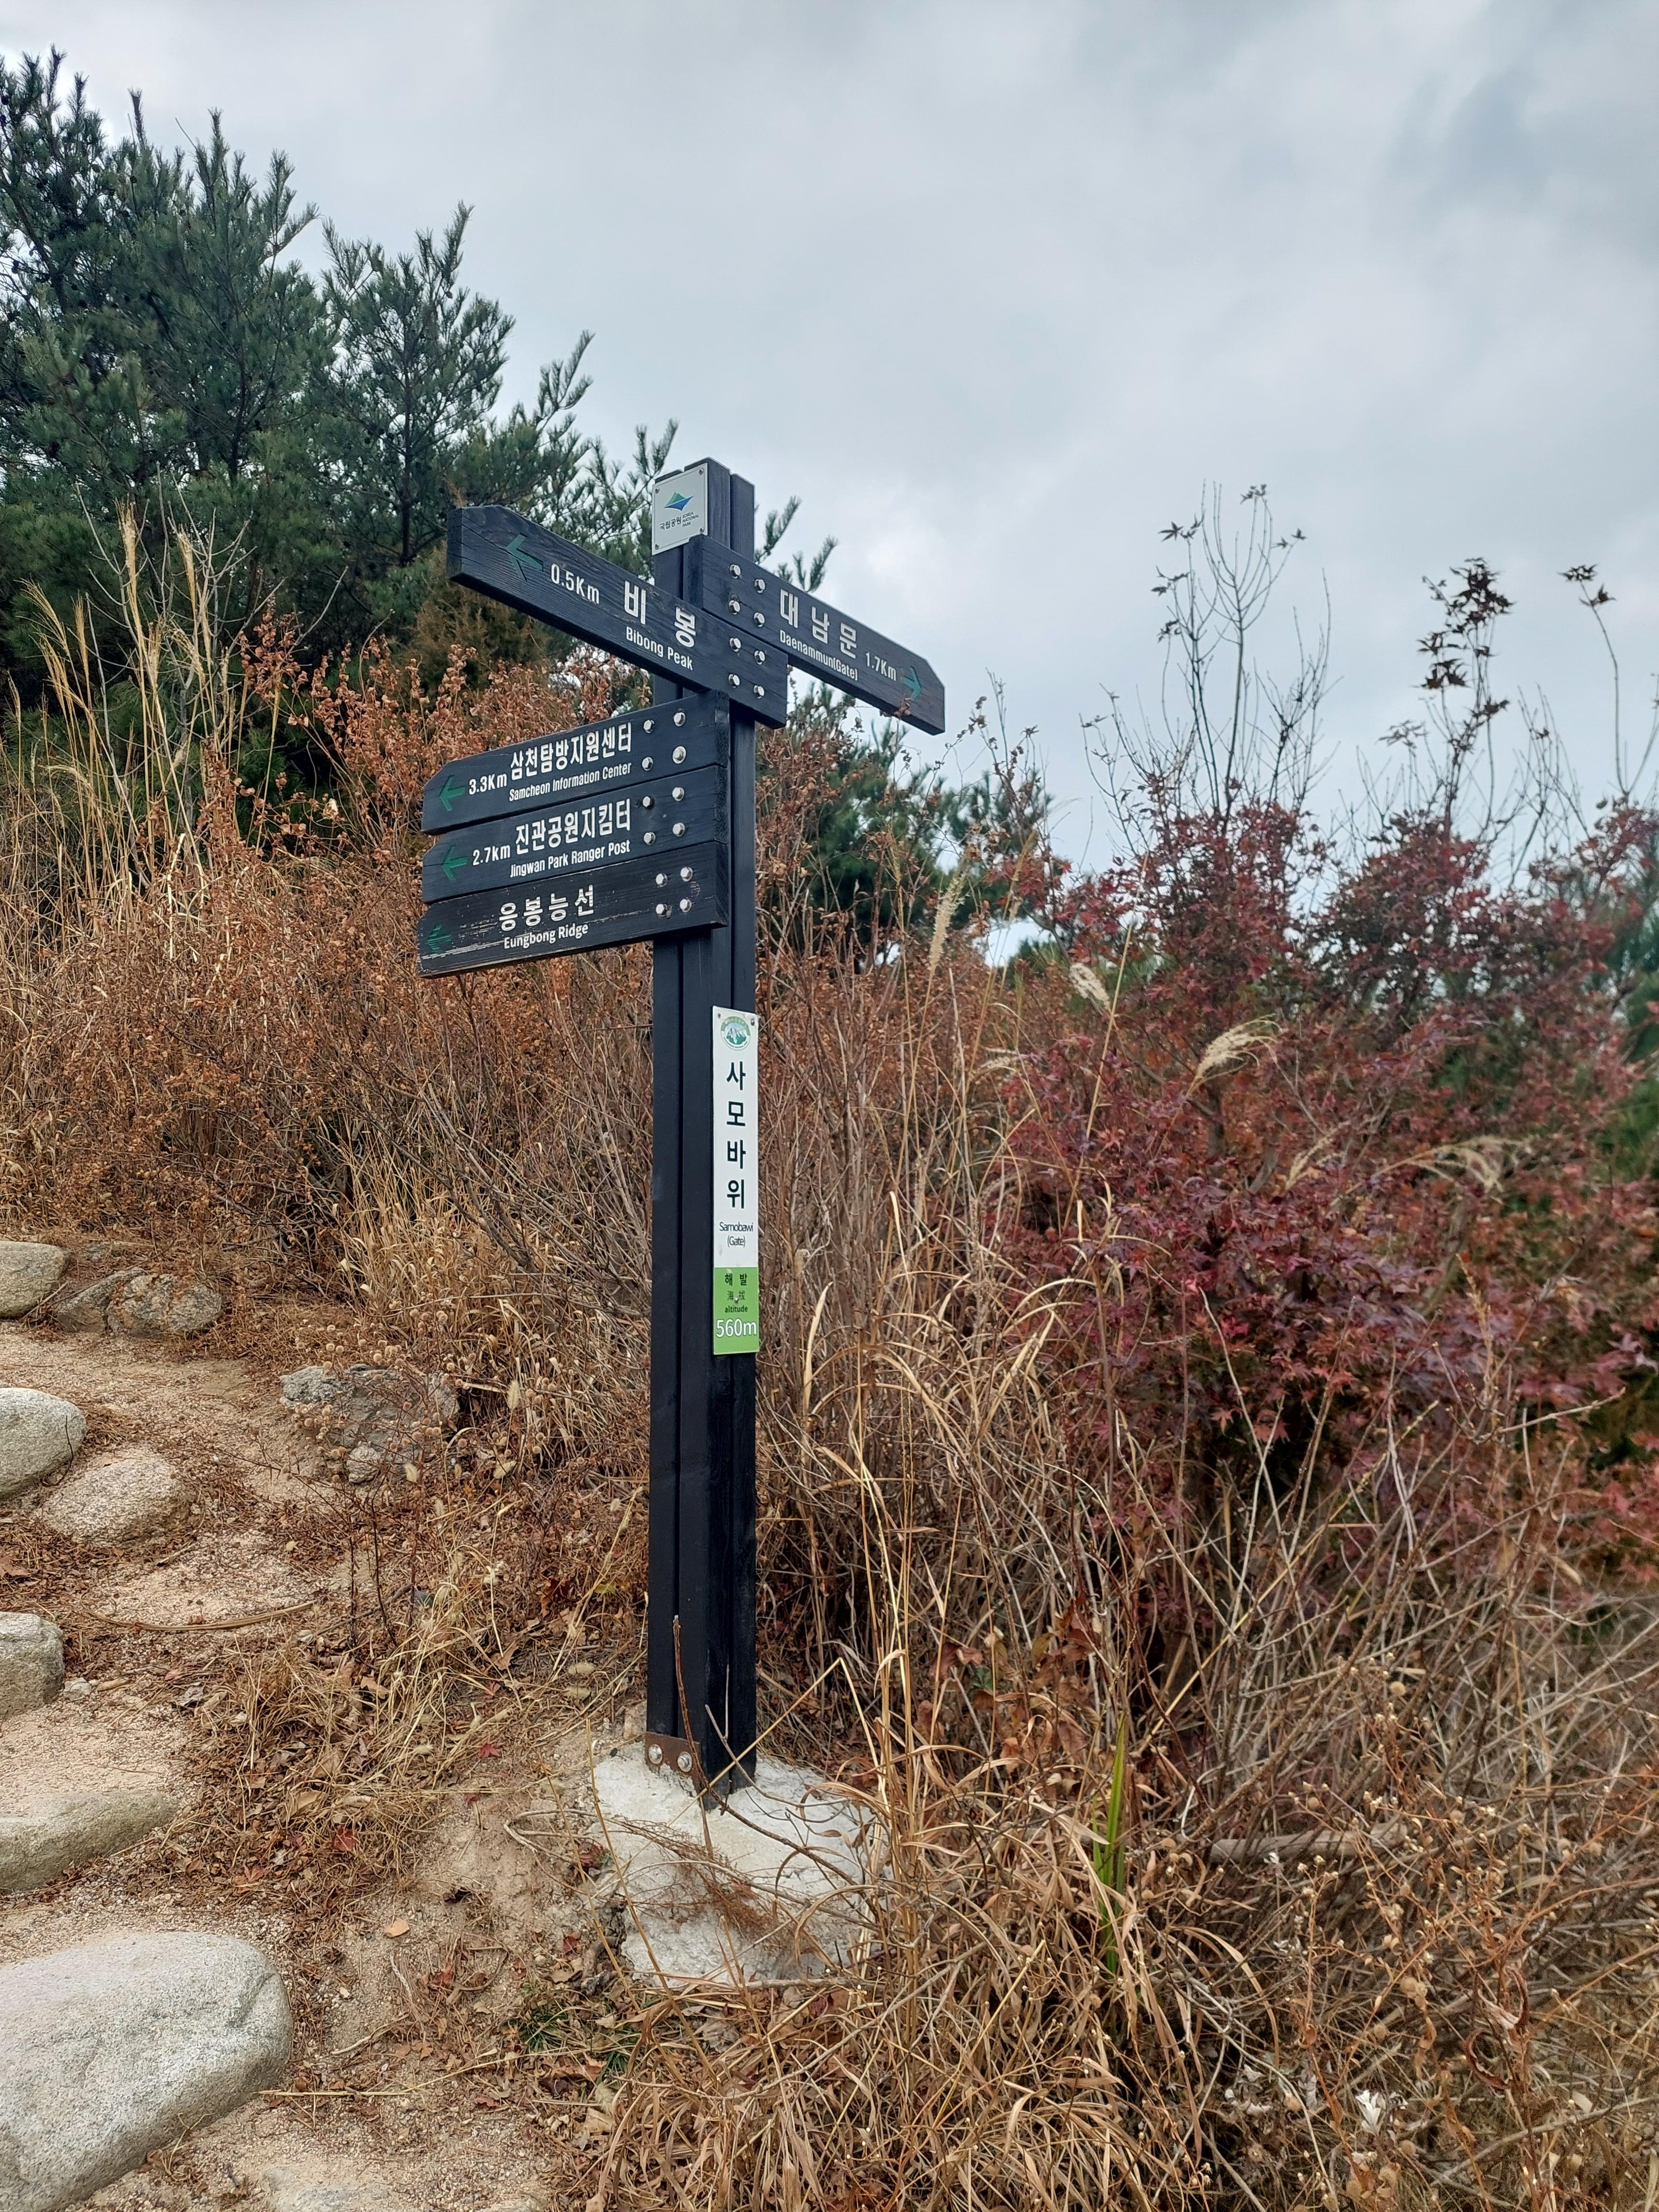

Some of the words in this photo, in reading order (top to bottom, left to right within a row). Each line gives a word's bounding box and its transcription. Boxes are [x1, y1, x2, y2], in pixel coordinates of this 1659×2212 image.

[659, 516, 682, 531] 국립공원
[682, 514, 699, 523] NATIONAL
[551, 563, 599, 605] 0.5Km
[626, 625, 664, 658] Bibong
[667, 646, 693, 671] Peak
[865, 651, 897, 681] 1.7Km
[510, 722, 632, 781] 삼천탐방지원센터
[468, 773, 507, 796] 3.3Km
[509, 781, 551, 802] Samcheon
[552, 769, 600, 792] Information
[602, 761, 632, 780] Center
[515, 798, 630, 855] 진관공원지킴터
[509, 860, 545, 878] Jingwan
[547, 852, 569, 869] Park
[571, 846, 605, 864] Ranger
[608, 839, 630, 857] Post
[504, 929, 556, 949] Eungbong
[558, 923, 589, 939] Ridge
[719, 1221, 753, 1232] Samobawi
[727, 1235, 746, 1248] (Gate)
[724, 1305, 748, 1313] altitude
[716, 1318, 757, 1338] 560m
